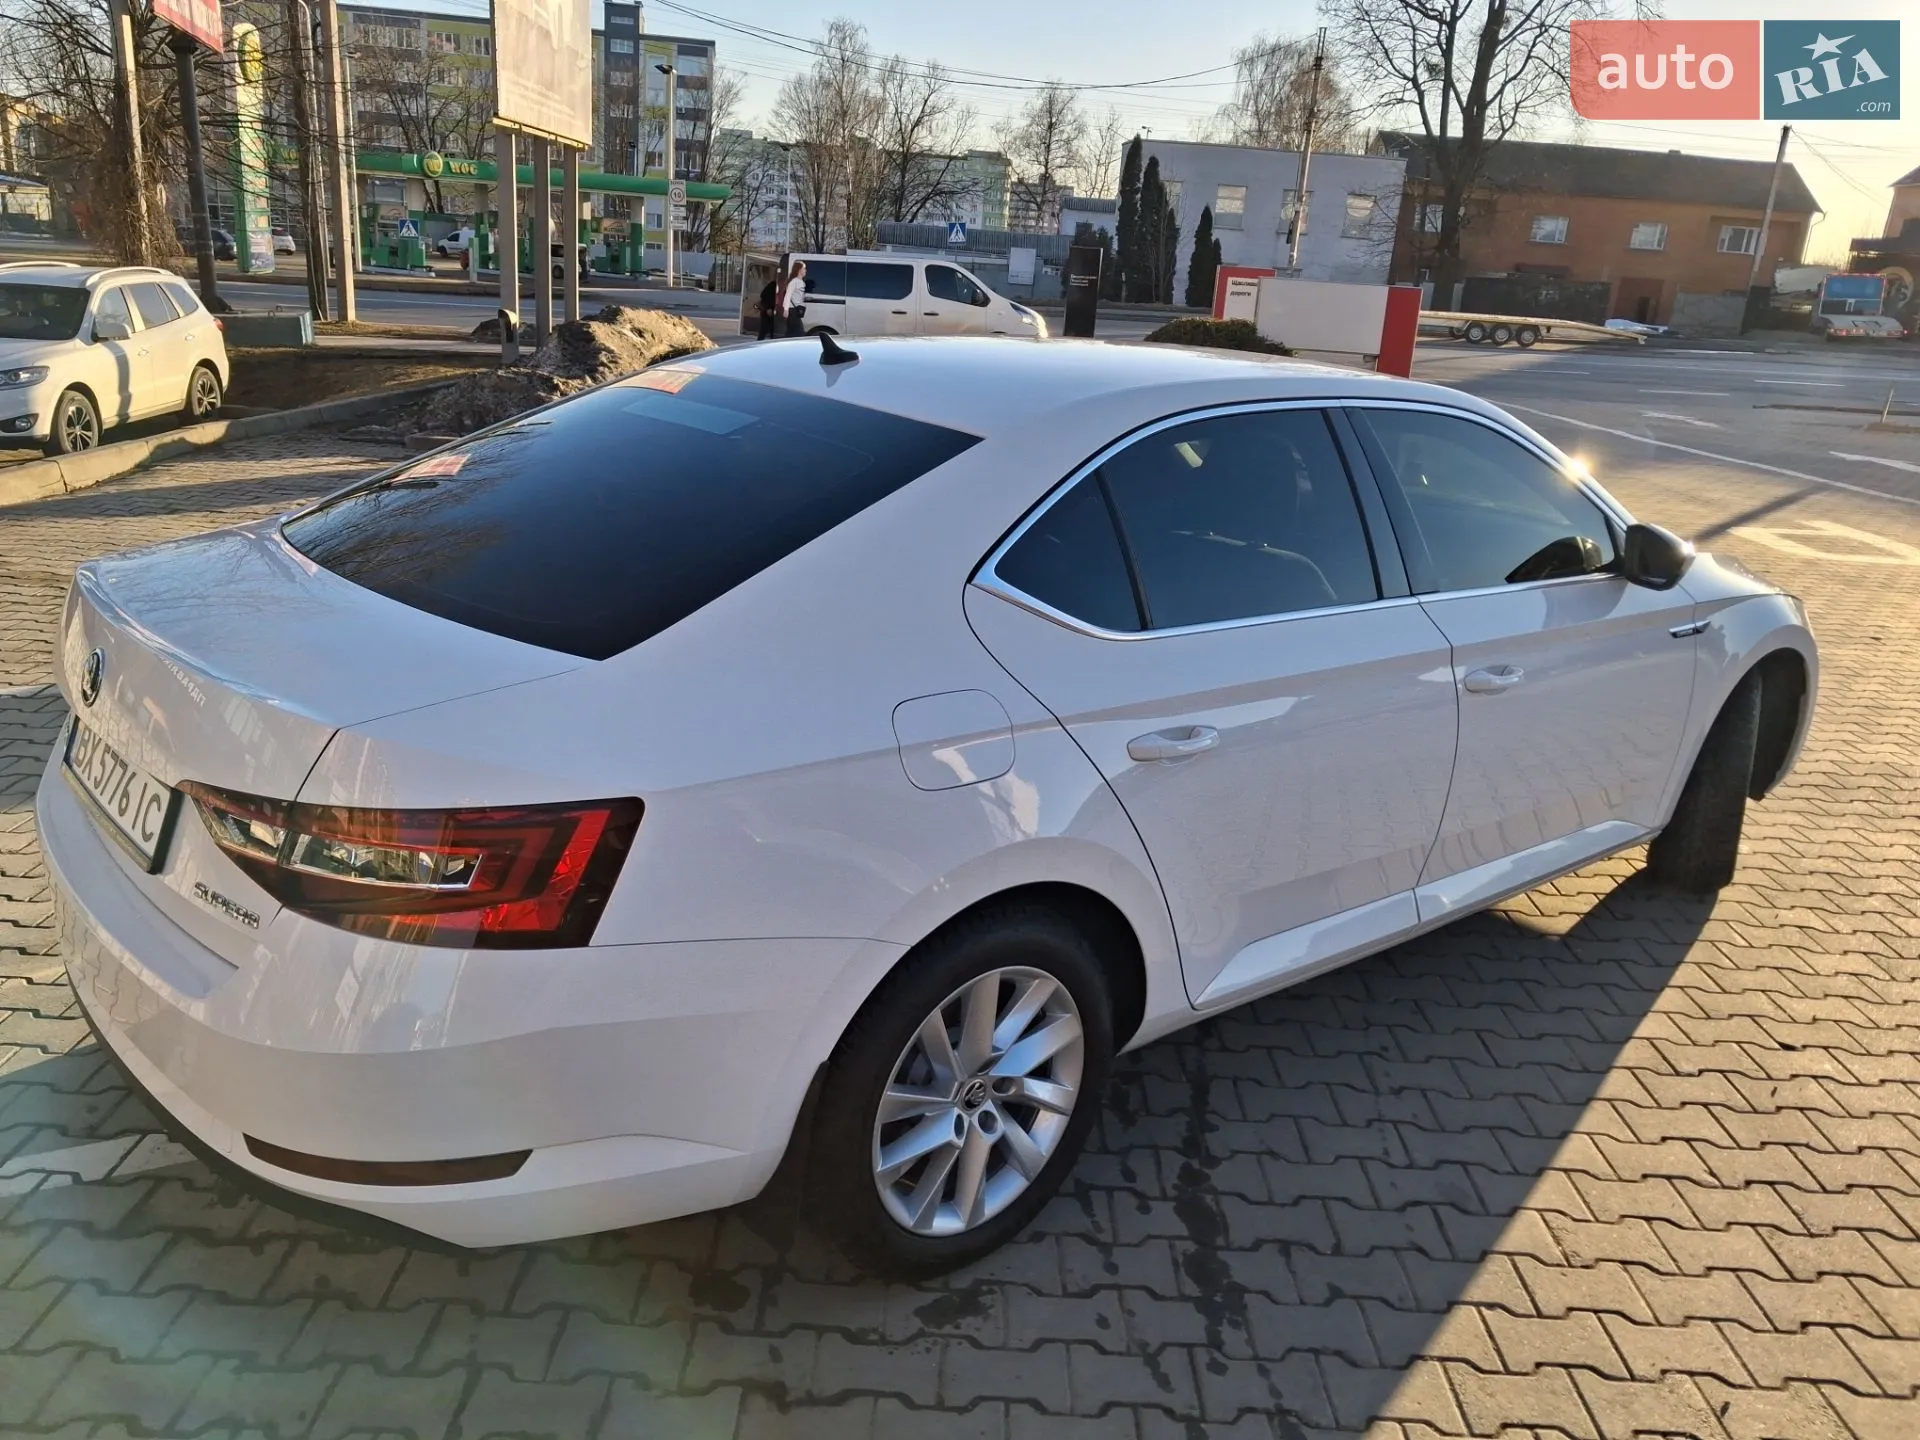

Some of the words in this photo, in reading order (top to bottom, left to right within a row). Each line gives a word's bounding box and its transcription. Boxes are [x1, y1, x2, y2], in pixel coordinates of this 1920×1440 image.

[673, 191, 682, 199] 10
[93, 745, 137, 818] 5776
[132, 782, 161, 843] IC
